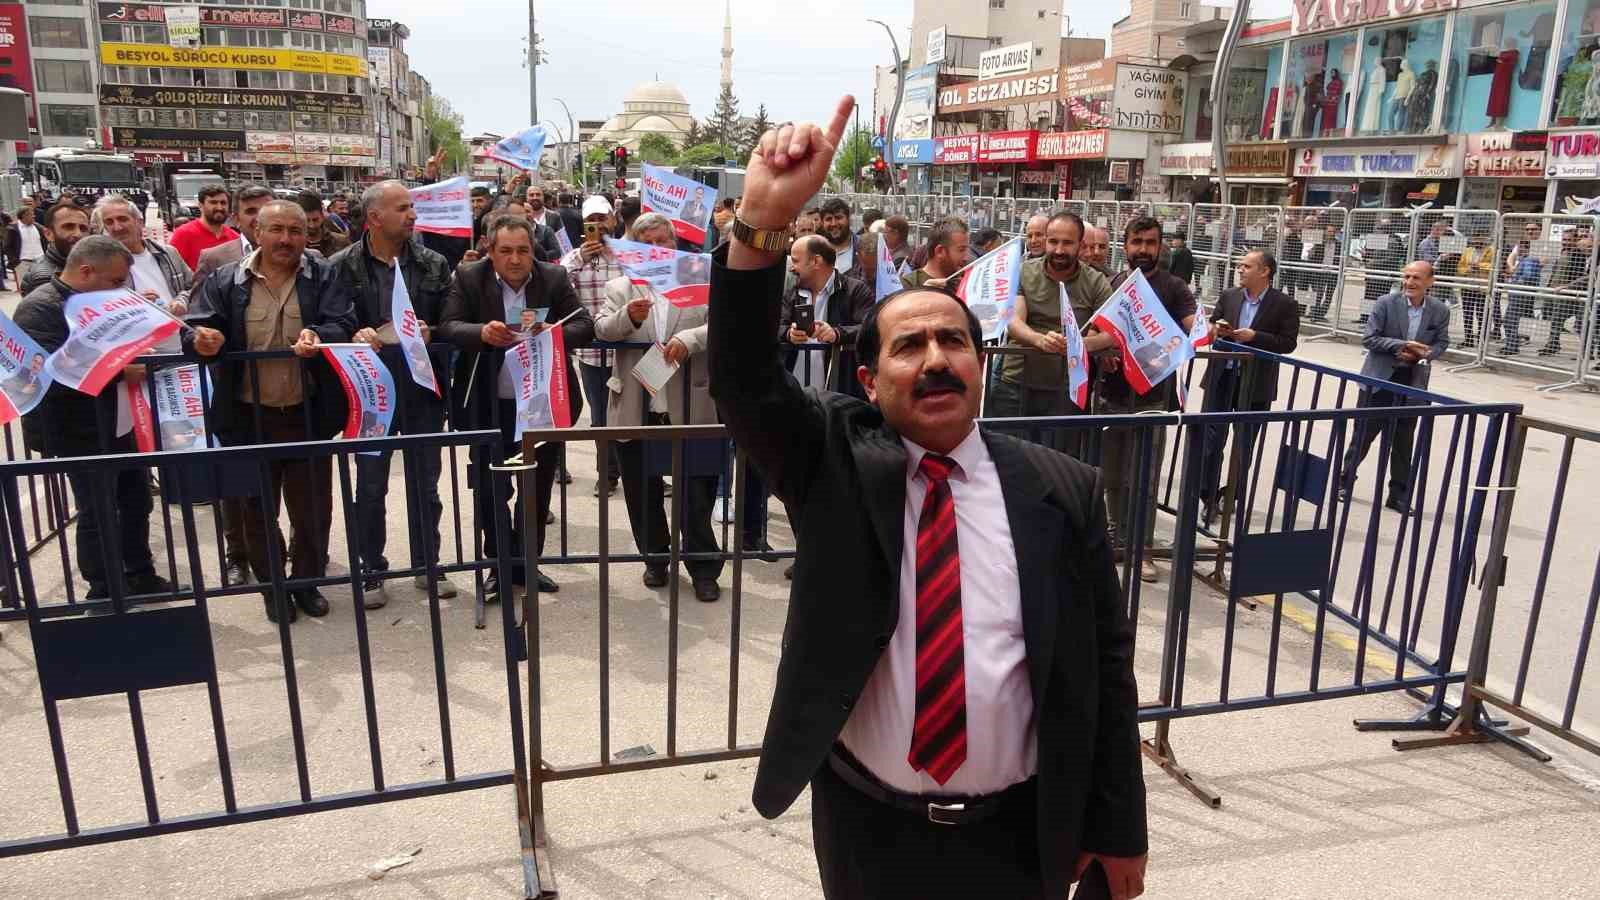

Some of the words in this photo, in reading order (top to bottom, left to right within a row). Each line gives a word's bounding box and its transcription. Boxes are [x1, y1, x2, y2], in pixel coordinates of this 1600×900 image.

[116, 50, 170, 63] BEŞYOL
[173, 48, 228, 64] SÜRÜCÜ
[231, 53, 277, 65] KURSU
[981, 55, 1001, 72] FOTO
[1002, 49, 1028, 68] ARVAS
[1129, 69, 1176, 83] YAĞMUR
[967, 69, 1059, 104] ECZANESİ
[1134, 86, 1167, 99] GİYİM
[155, 91, 186, 104] GOLD
[242, 94, 287, 107] SALONU
[1117, 107, 1181, 129] İNDİRİM
[944, 138, 971, 149] BEŞYOL
[1550, 133, 1600, 157] TUR
[944, 151, 969, 161] DÖNER
